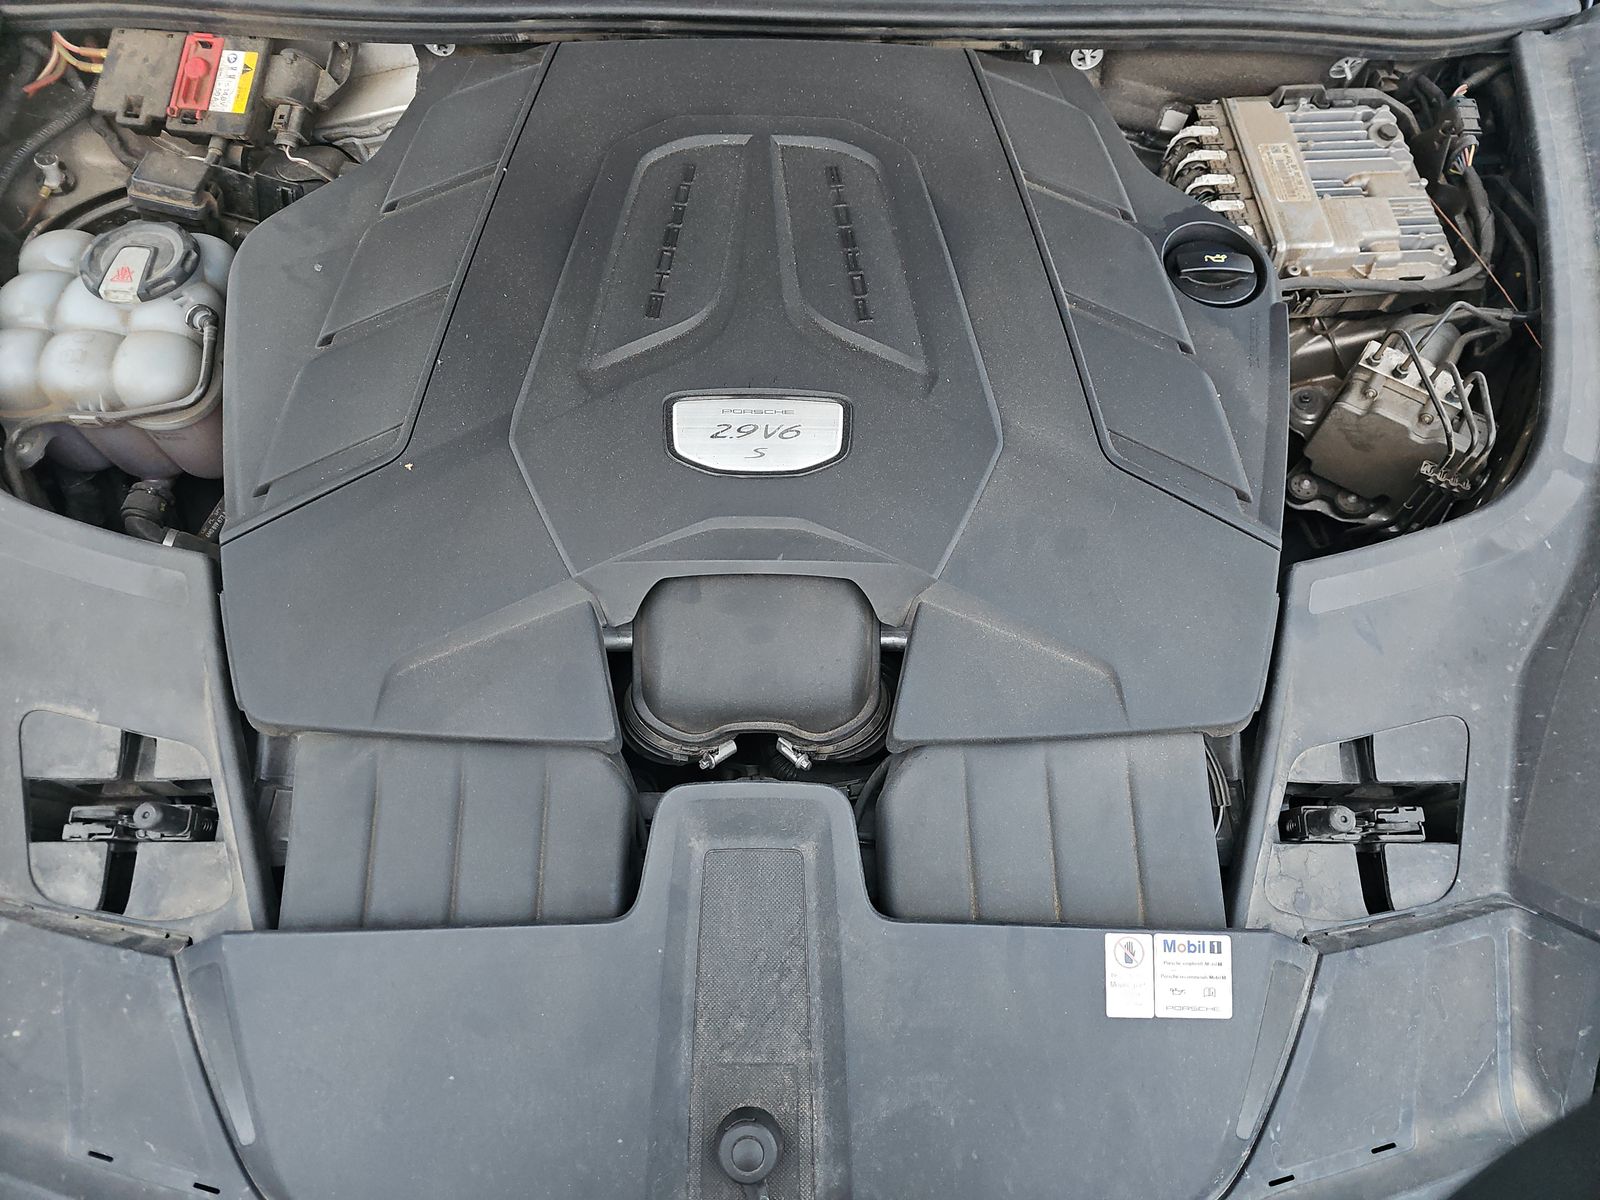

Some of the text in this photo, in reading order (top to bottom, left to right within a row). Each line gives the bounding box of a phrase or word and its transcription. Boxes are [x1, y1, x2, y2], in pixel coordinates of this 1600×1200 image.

[645, 163, 696, 319] PORSCHE
[825, 165, 874, 322] PORSCHE
[744, 447, 768, 459] S
[1163, 939, 1222, 954] Mobil 1
